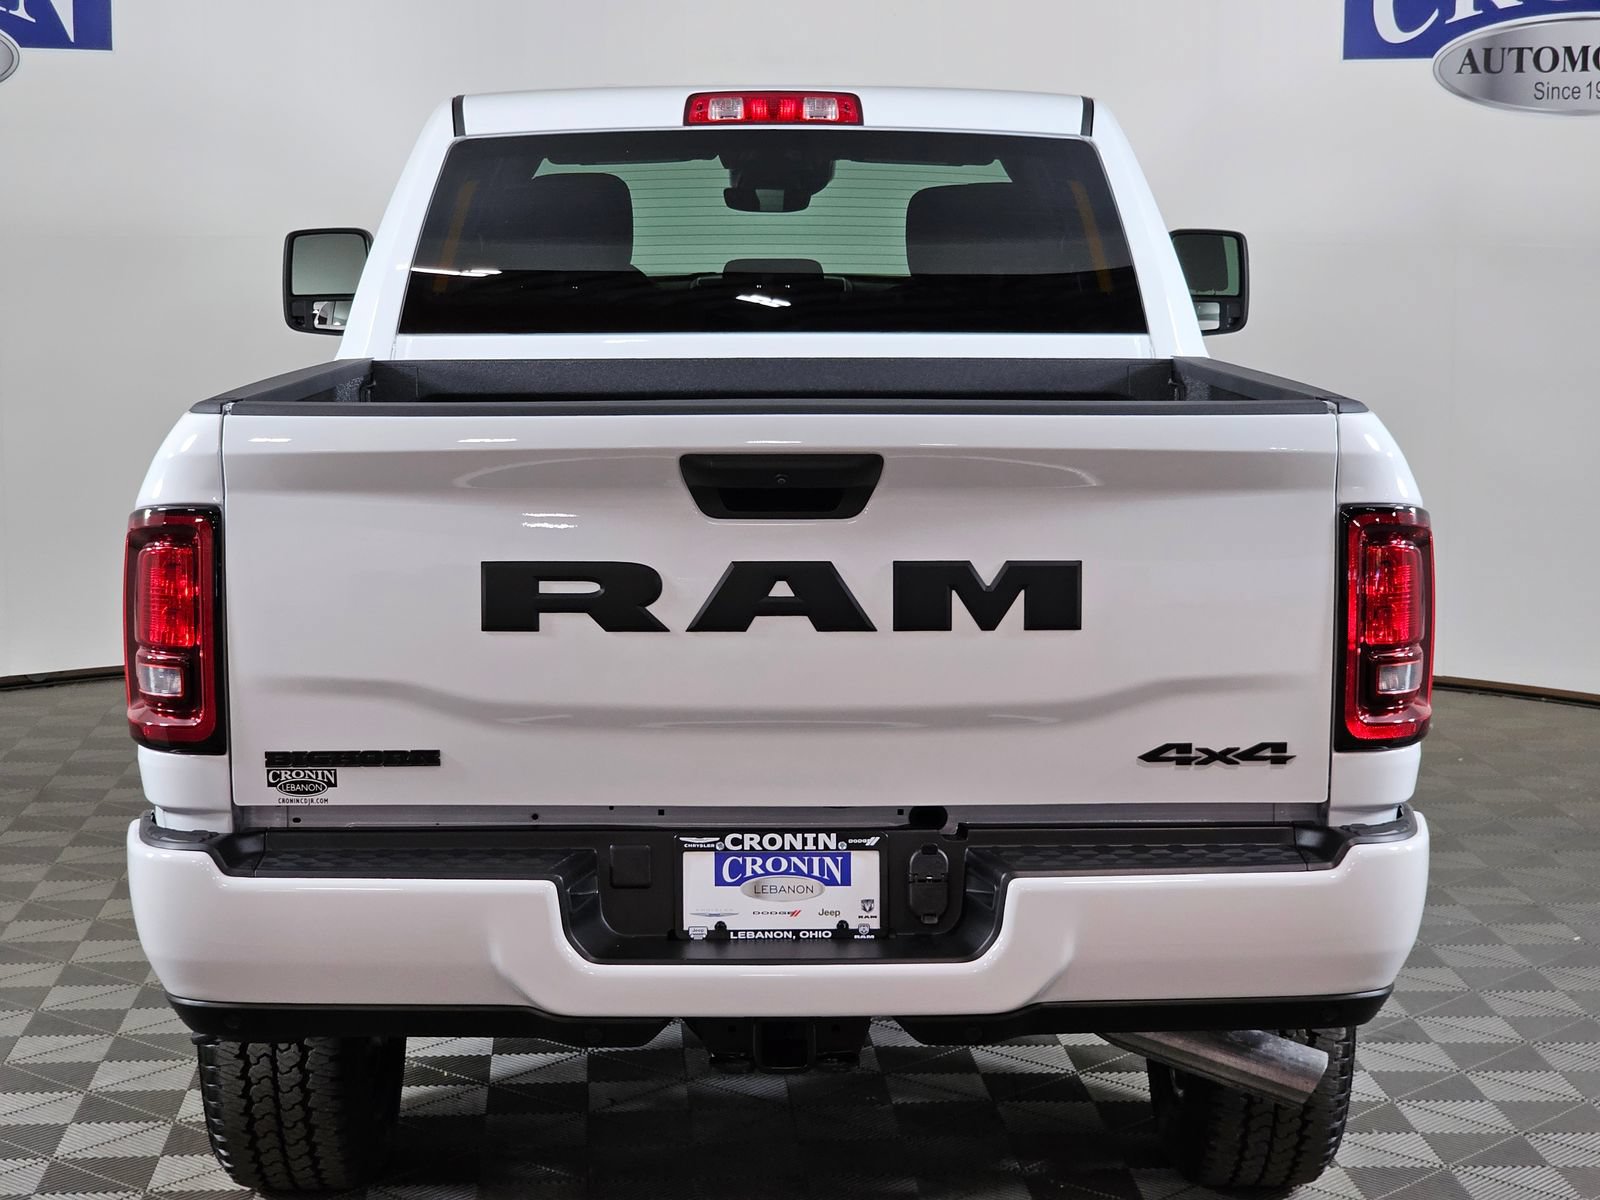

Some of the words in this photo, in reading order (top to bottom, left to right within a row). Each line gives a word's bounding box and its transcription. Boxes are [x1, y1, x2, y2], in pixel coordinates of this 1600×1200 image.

[1456, 45, 1600, 74] AUTOM
[1533, 81, 1581, 100] Since
[481, 561, 1083, 632] RAM
[268, 769, 336, 785] CRONIN
[281, 783, 323, 792] LEBANON
[724, 833, 837, 850] CRONIN
[722, 856, 843, 884] CRONIN
[753, 885, 814, 895] LEBANON
[818, 908, 841, 918] Jeep
[730, 931, 796, 940] LEBANON,
[799, 930, 832, 939] OHIO
